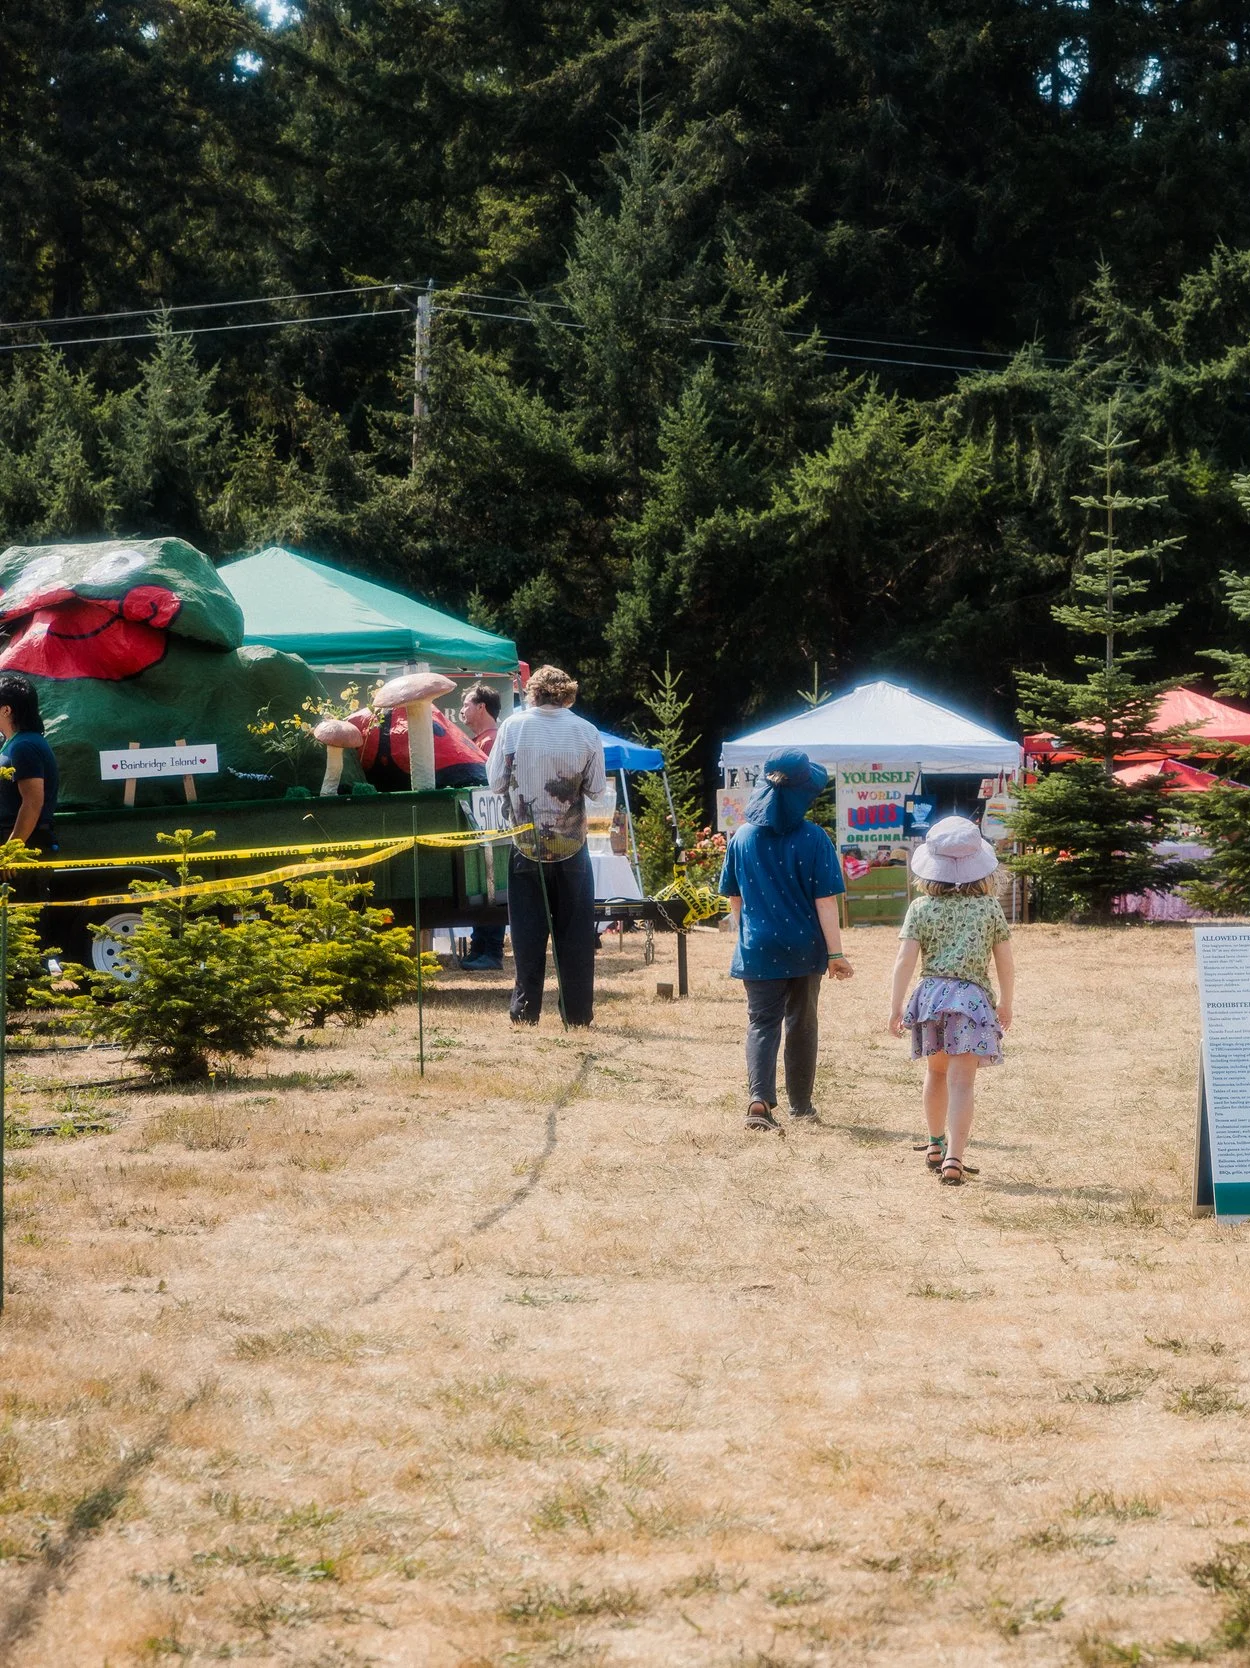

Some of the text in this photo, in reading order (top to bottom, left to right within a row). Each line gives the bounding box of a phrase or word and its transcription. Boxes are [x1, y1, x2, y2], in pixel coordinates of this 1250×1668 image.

[120, 756, 197, 771] Bainbridge Island
[841, 771, 915, 784] YOURSELF
[857, 791, 901, 800] WORLD
[848, 803, 897, 827] LOVES
